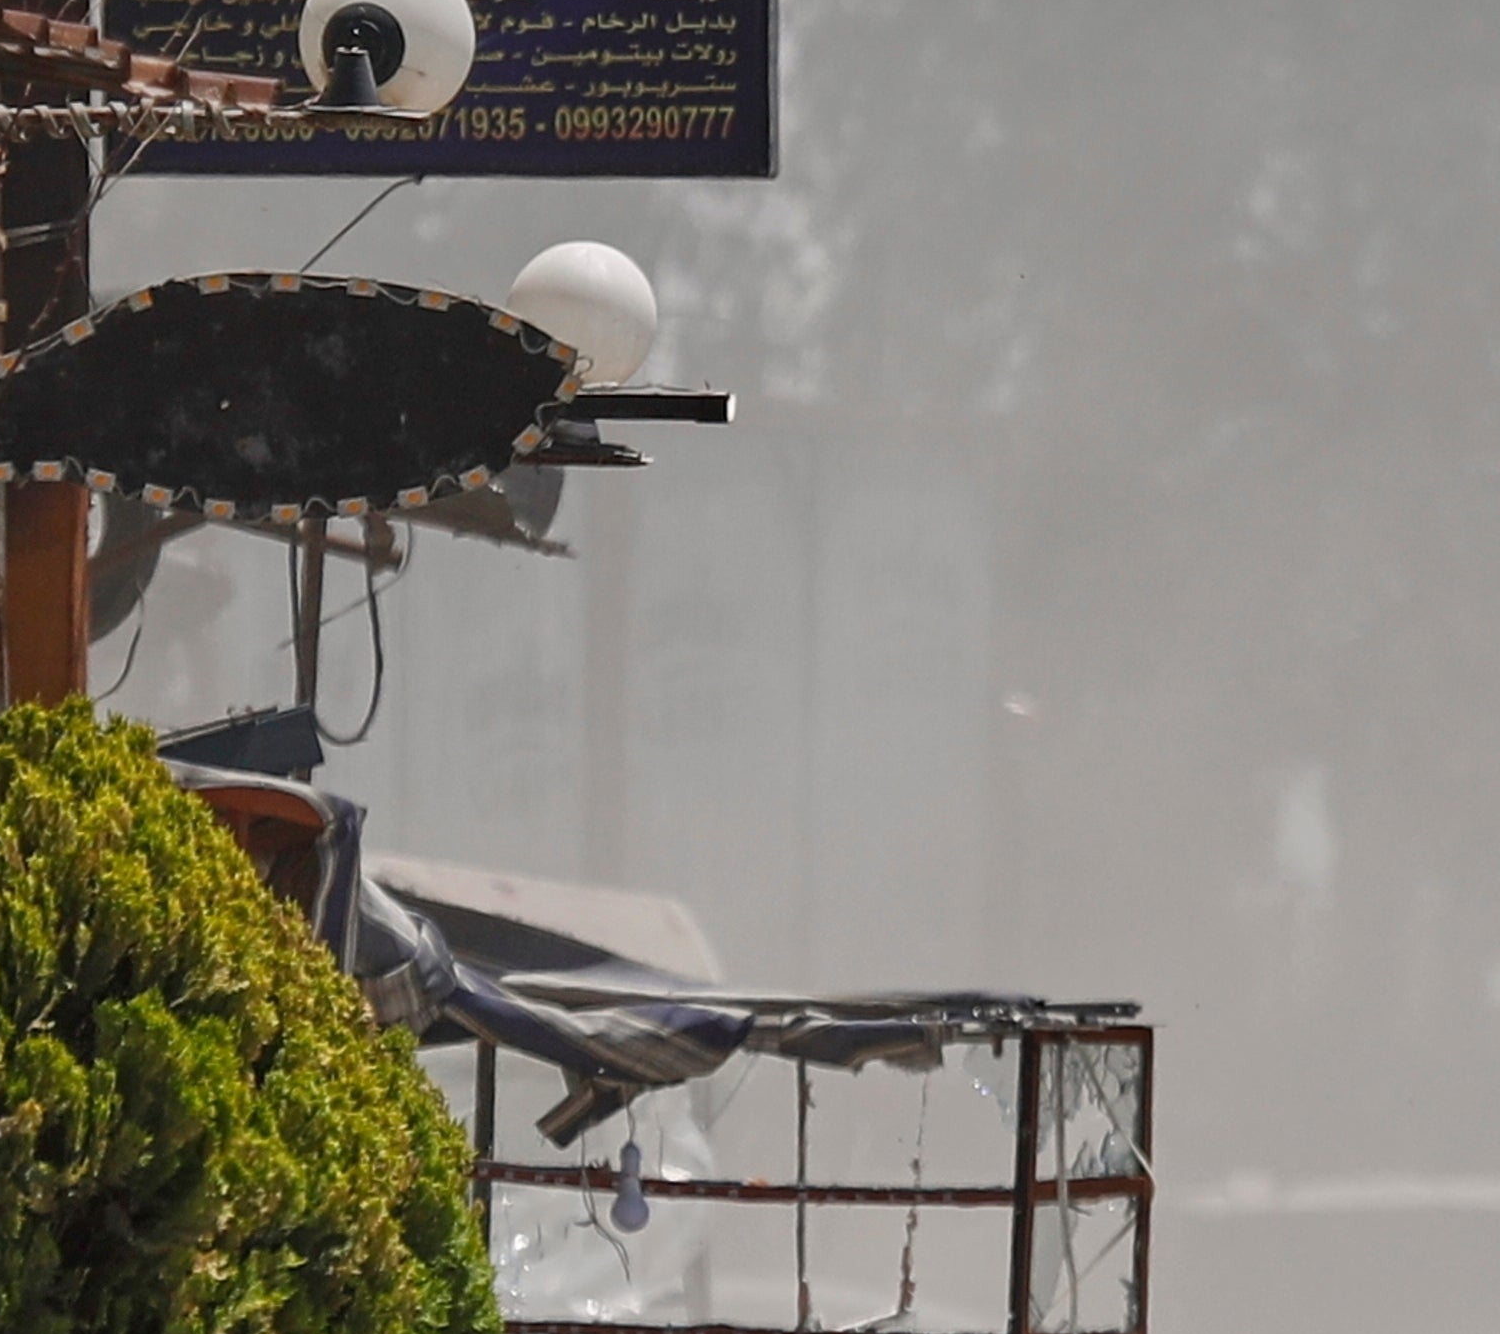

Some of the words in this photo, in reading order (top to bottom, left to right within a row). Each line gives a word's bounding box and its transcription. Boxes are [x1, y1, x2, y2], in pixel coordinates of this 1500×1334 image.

[581, 12, 656, 35] الرخام
[664, 12, 737, 35] بديل
[670, 43, 737, 66] رولات
[554, 104, 735, 142] 0993290777
